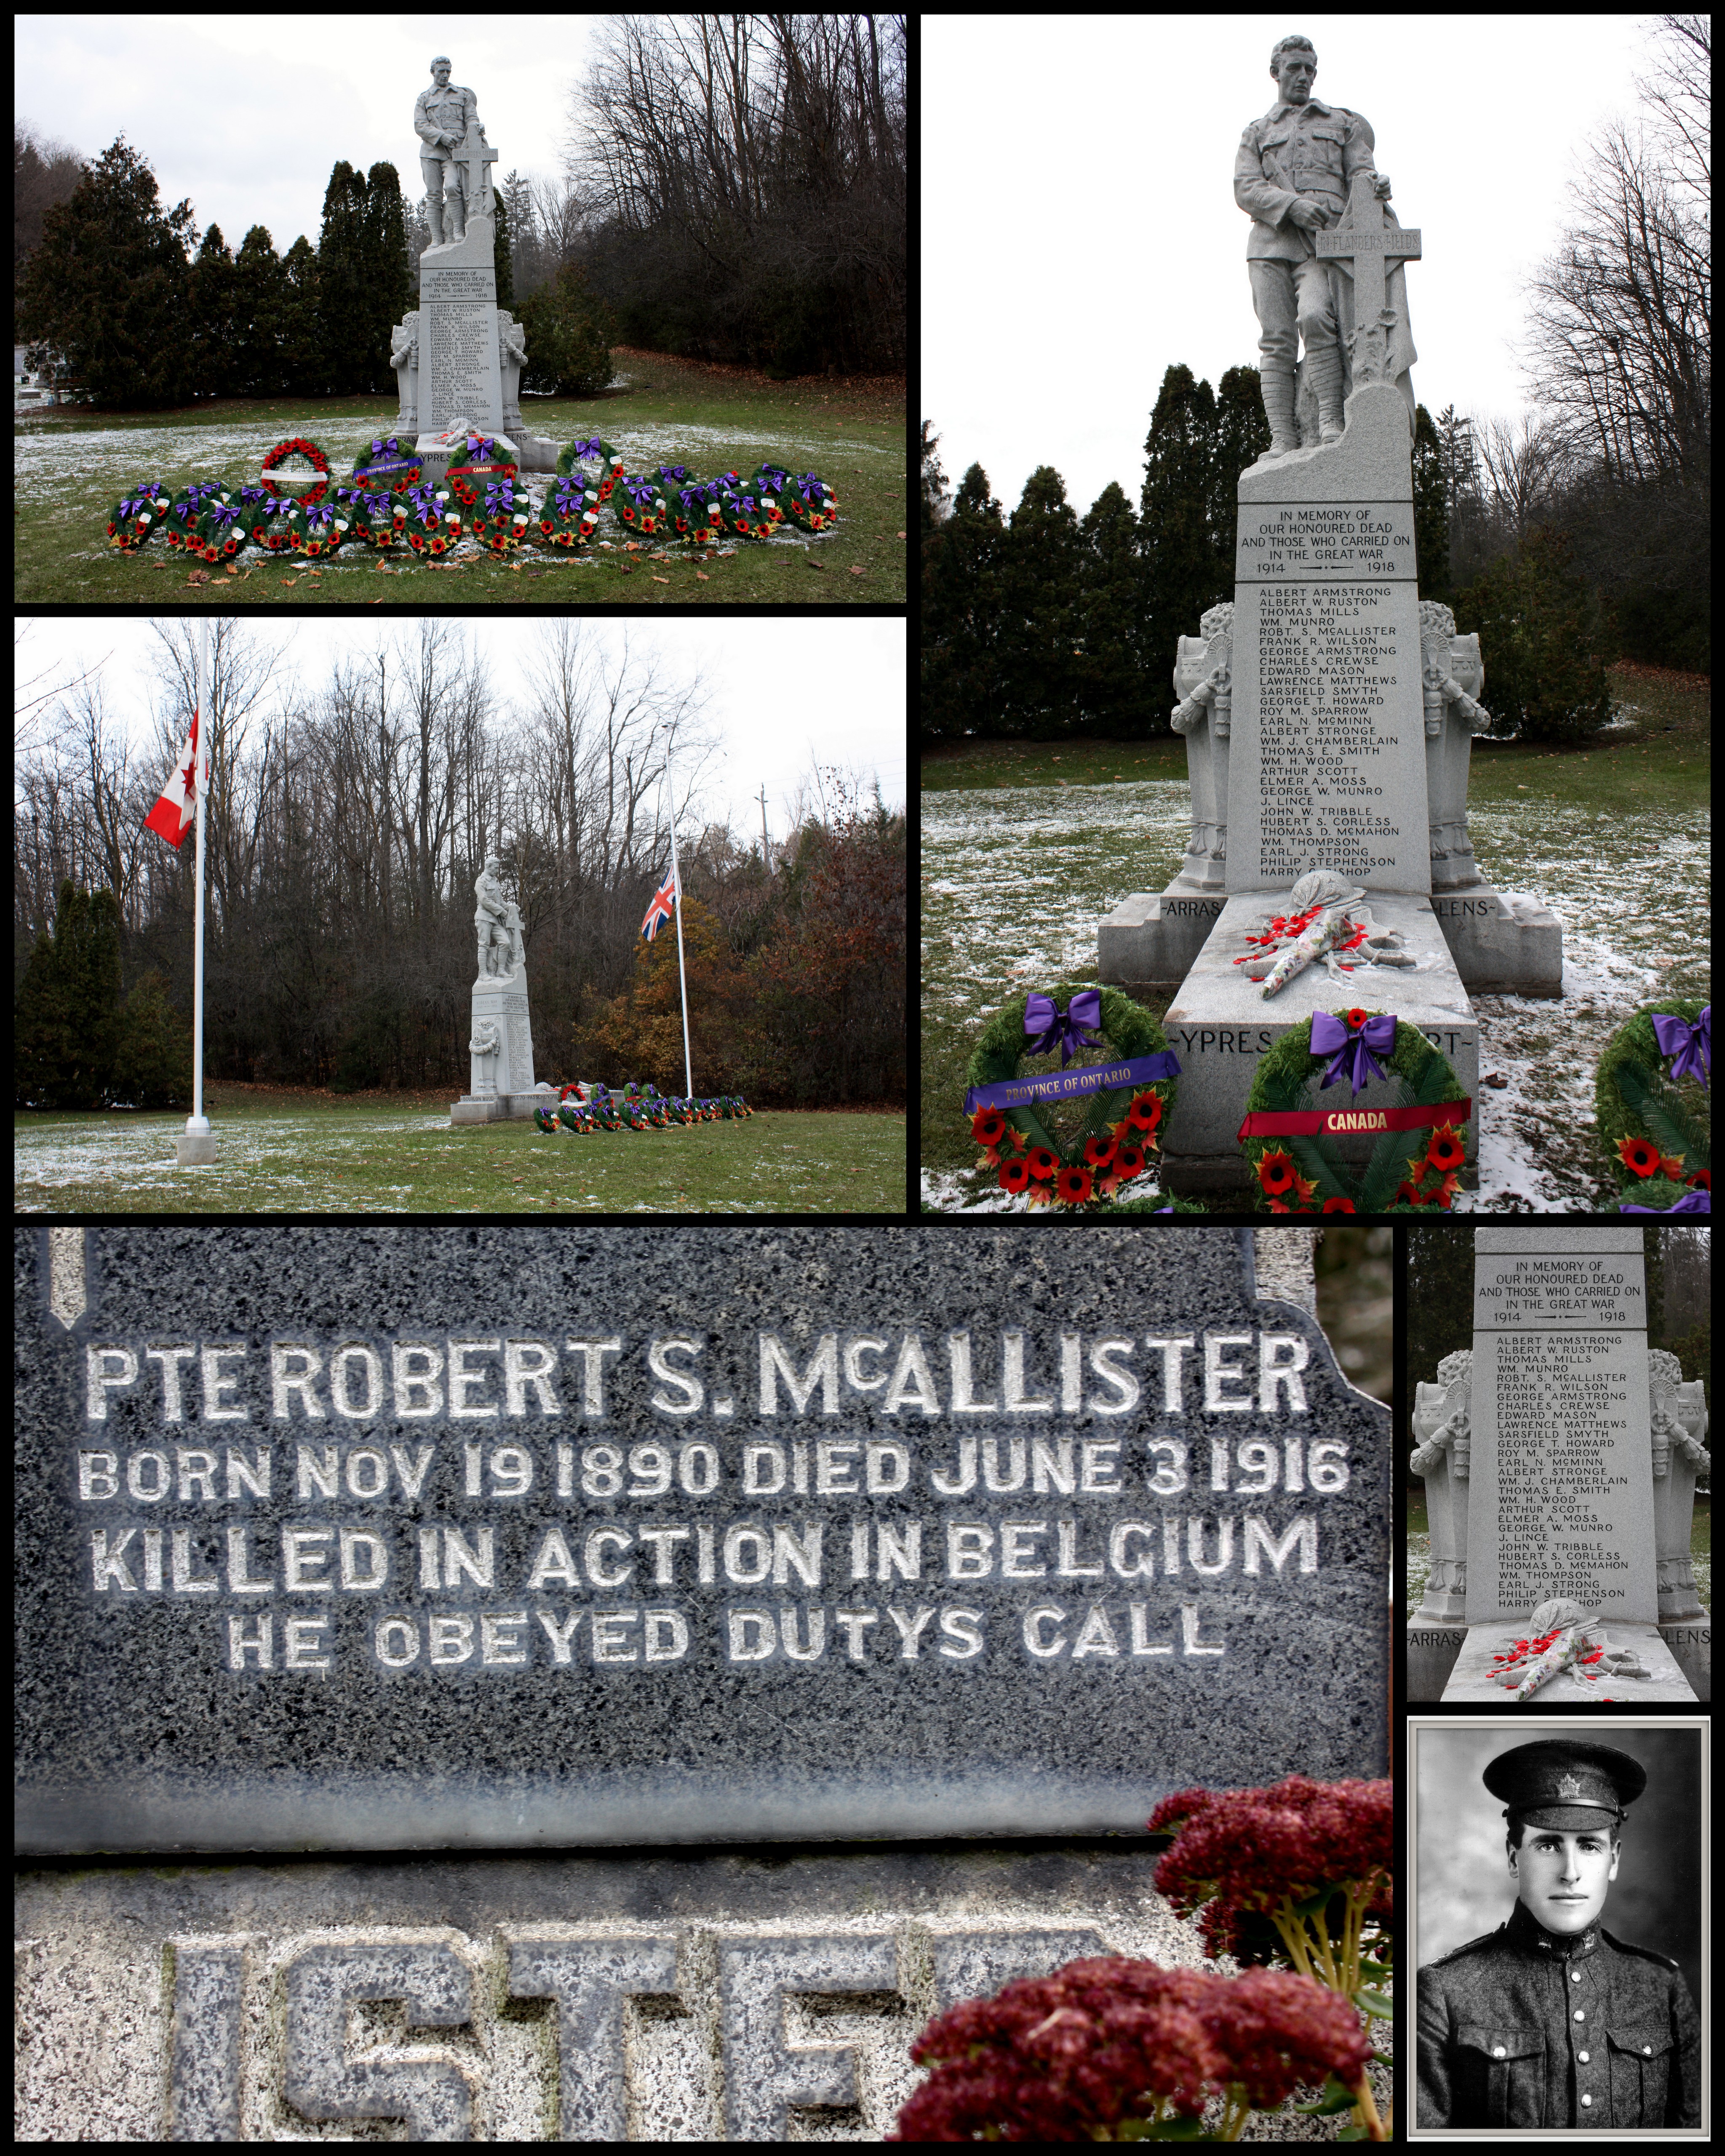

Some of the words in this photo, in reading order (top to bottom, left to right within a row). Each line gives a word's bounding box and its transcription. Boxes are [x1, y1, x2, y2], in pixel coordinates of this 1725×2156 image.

[1281, 512, 1292, 521] IN
[1298, 511, 1351, 520] MEMORY
[1356, 510, 1370, 520] OF
[1260, 525, 1284, 534] OUR
[1290, 524, 1354, 534] HONOURED
[1361, 523, 1392, 533] DEAD
[1242, 538, 1265, 547] AND
[1270, 537, 1305, 547] THOSE
[1311, 536, 1335, 546] WHO
[1341, 536, 1389, 546] CARRIED
[1394, 536, 1409, 545] ON
[1270, 551, 1281, 560] IN
[1287, 550, 1309, 560] THE
[1315, 550, 1354, 559] GREAT
[1359, 549, 1383, 558] WAR
[1258, 563, 1285, 574] 1914
[1368, 562, 1394, 573] 1918
[1313, 588, 1391, 596] ARMSTRONG
[1260, 598, 1306, 606] ALBERT
[1330, 598, 1377, 606] RUSTON
[1260, 608, 1311, 616] THOMAS
[1290, 618, 1334, 626] MUNRO
[1260, 638, 1301, 646] FRANK
[1327, 637, 1376, 645] WILSON
[1260, 648, 1309, 656] GEORGE
[1317, 647, 1396, 655] ARMSTRONG
[1260, 657, 1317, 665] CHARLES
[1327, 657, 1378, 665] CREWSE
[1319, 667, 1364, 675] MASON
[1006, 1081, 1060, 1101] PROVINCE
[1064, 1077, 1078, 1091] OF
[1081, 1068, 1131, 1088] ONTARIO
[1328, 1112, 1387, 1130] CANADA
[85, 1342, 248, 1422] PTE
[271, 1336, 620, 1418] ROBERT
[649, 1336, 733, 1415] S.
[77, 1445, 271, 1500] BORN
[297, 1445, 434, 1499] NOV
[464, 1442, 533, 1497] 19
[556, 1442, 719, 1497] 1890
[743, 1439, 910, 1495] DIED
[931, 1437, 1122, 1494] JUNE
[1147, 1436, 1186, 1495] 3
[1211, 1436, 1348, 1493] 1916
[88, 1526, 388, 1593] KILLED
[420, 1525, 494, 1589] IN
[527, 1521, 822, 1589] ACTION
[850, 1520, 921, 1580] IN
[947, 1515, 1318, 1578] BELGIUM
[1551, 1580, 1599, 1588] STRONG
[1544, 1590, 1624, 1598] STEPHENSON
[229, 1610, 331, 1670] HE
[376, 1608, 689, 1666] OBEYED
[728, 1604, 984, 1661] DUTYS
[1022, 1601, 1226, 1658] CALL
